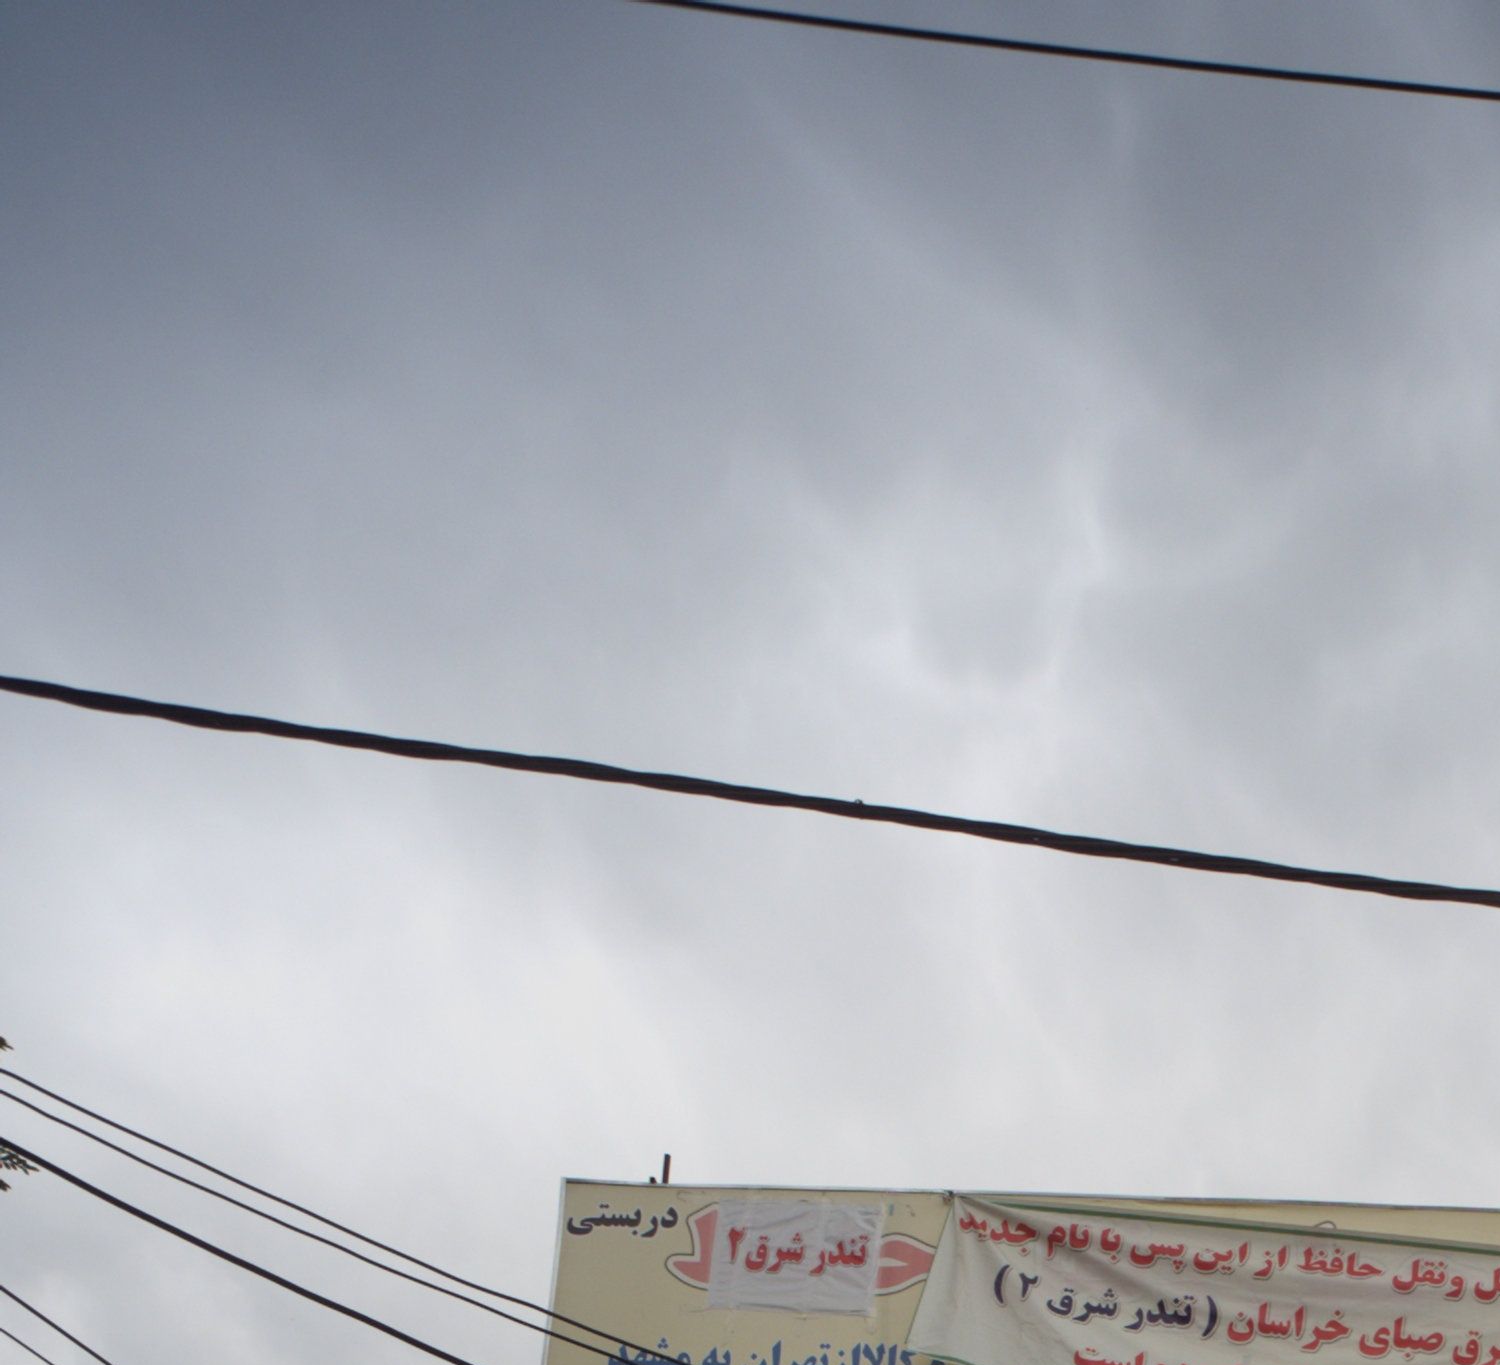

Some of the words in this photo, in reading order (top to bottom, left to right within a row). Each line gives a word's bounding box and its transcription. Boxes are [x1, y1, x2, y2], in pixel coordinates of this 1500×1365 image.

[567, 1203, 679, 1238] دربستی
[959, 1212, 1037, 1256] جدید
[728, 1226, 748, 1264] ۲
[744, 1232, 805, 1274] شرق
[808, 1233, 870, 1276] تندر
[1046, 1222, 1090, 1258] نام
[1100, 1226, 1122, 1262] با
[1130, 1243, 1186, 1271] پس
[1193, 1241, 1248, 1273] این
[1253, 1246, 1286, 1280] از
[1295, 1246, 1381, 1279] حافظ
[1046, 1288, 1121, 1322] شرق
[1226, 1301, 1349, 1356] خراسان
[1357, 1316, 1442, 1359] صبای
